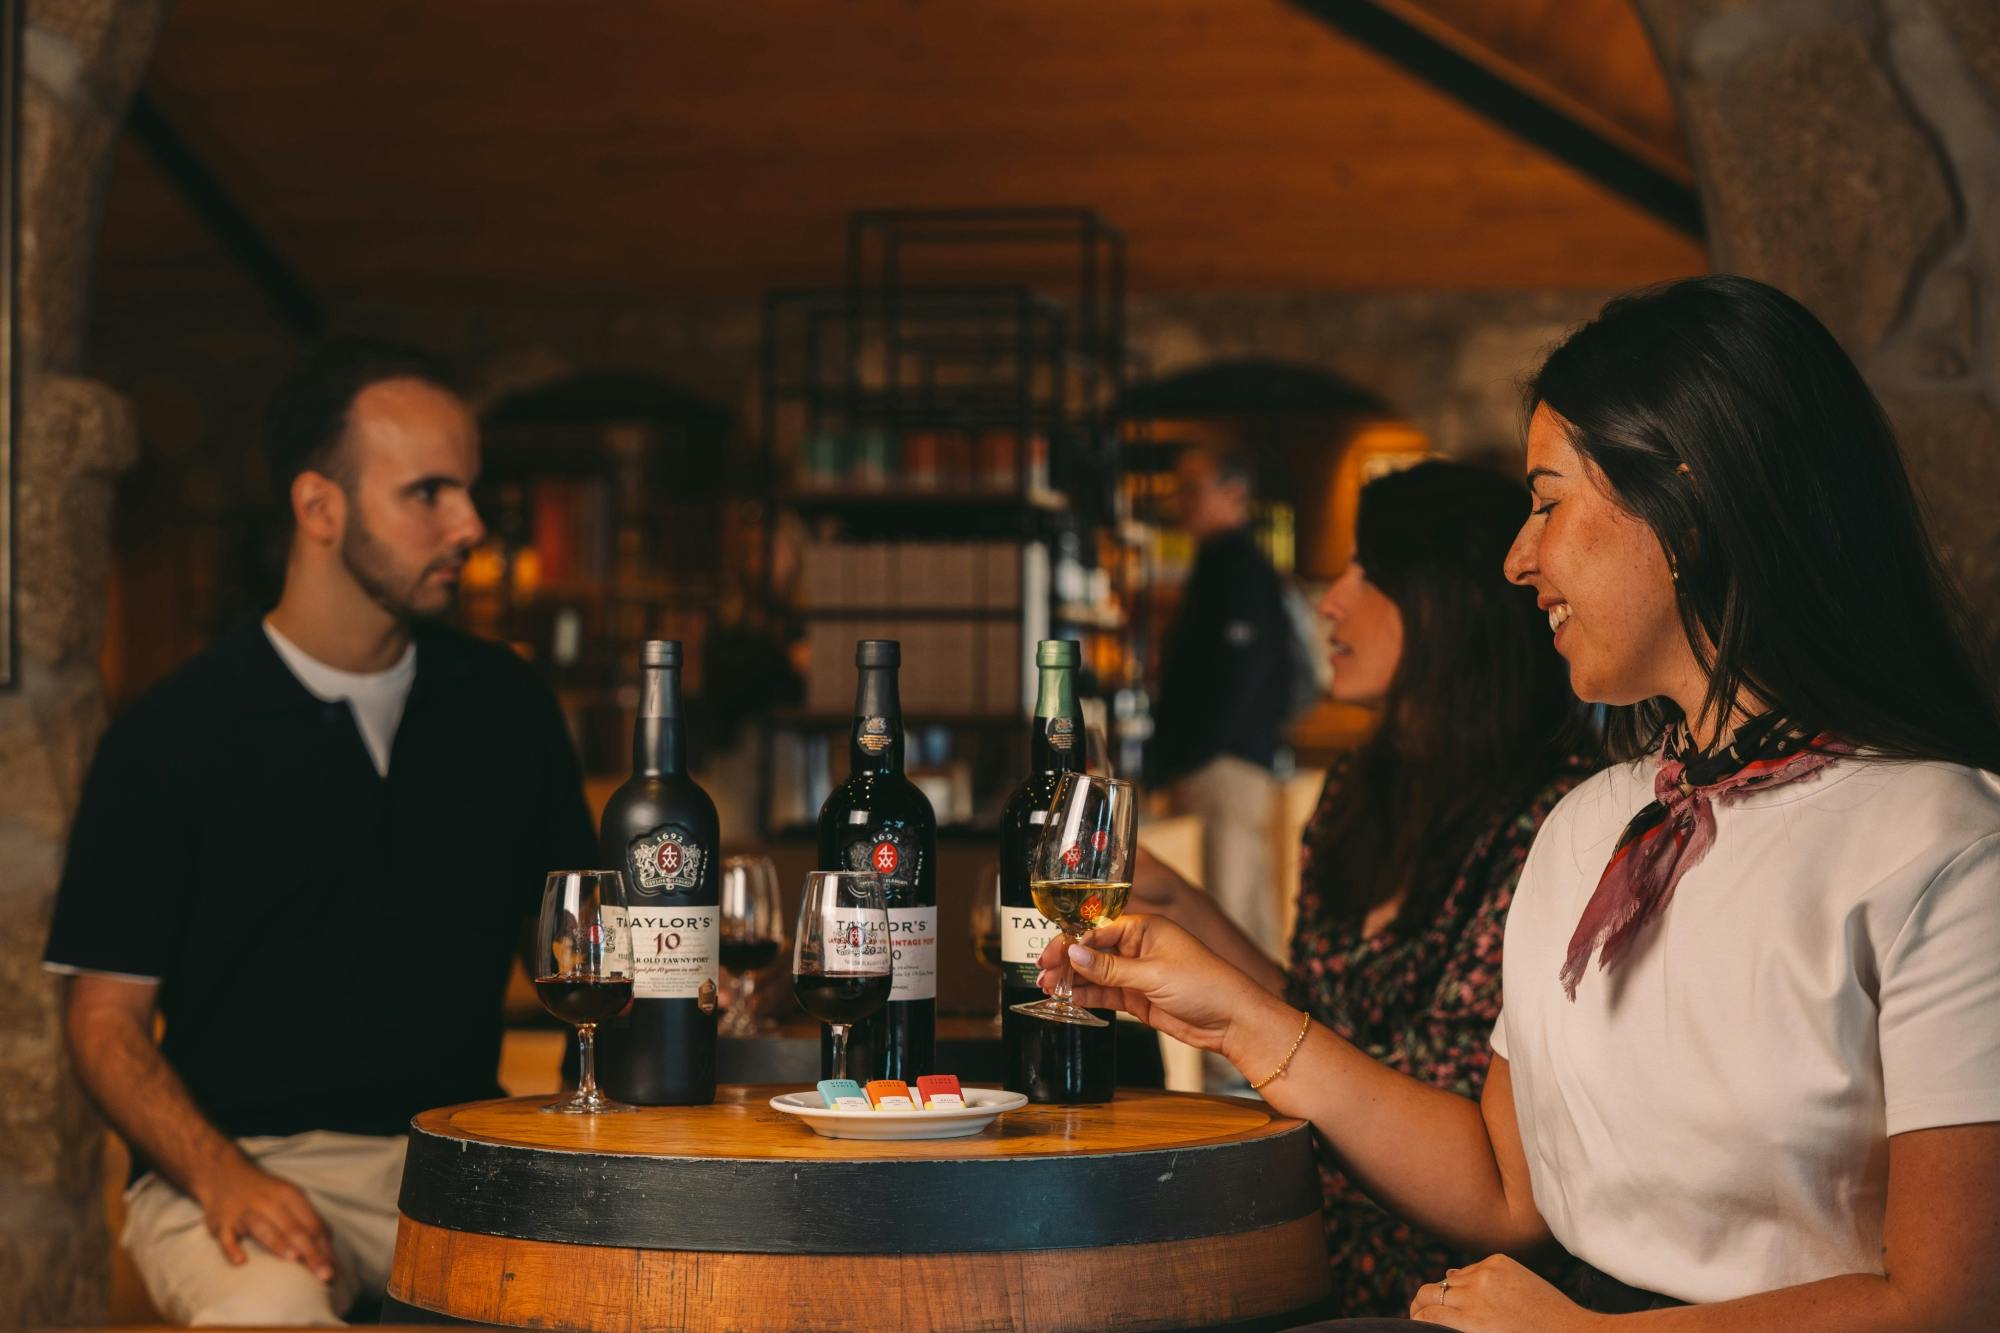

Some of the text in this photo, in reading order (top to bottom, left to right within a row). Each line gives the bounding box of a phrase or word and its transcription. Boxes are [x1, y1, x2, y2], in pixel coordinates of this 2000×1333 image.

[656, 832, 683, 843] 1692
[873, 833, 899, 844] 1692
[653, 932, 681, 956] 10
[643, 956, 660, 965] OLD
[663, 956, 691, 965] TAWNY
